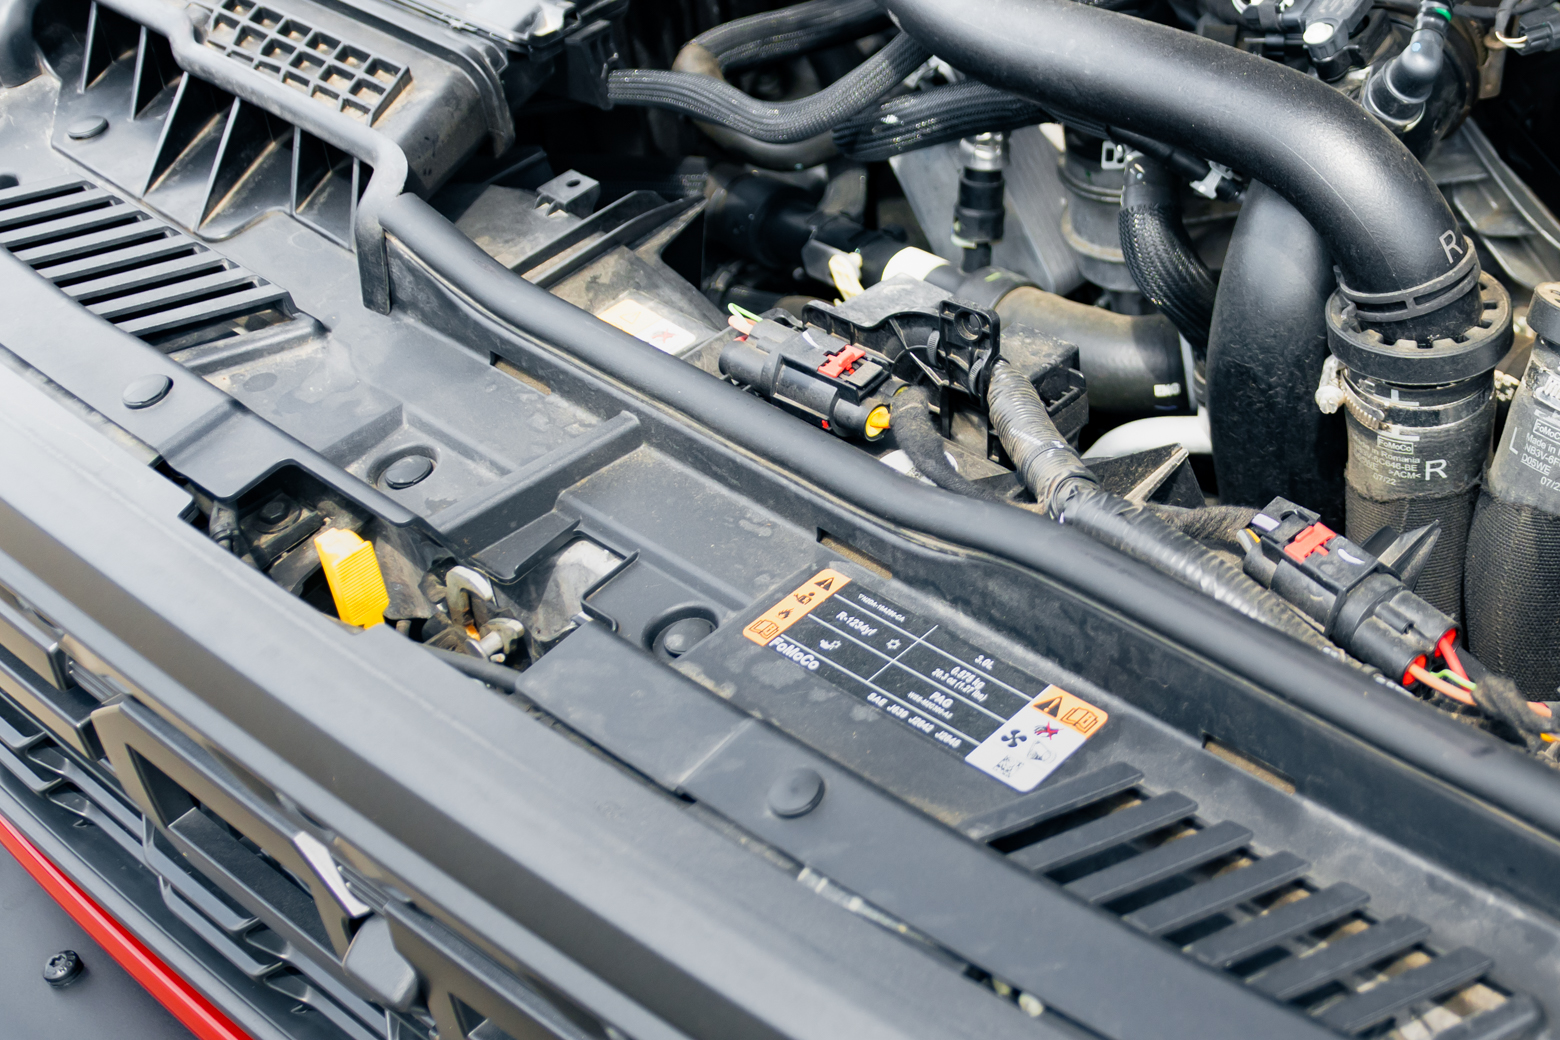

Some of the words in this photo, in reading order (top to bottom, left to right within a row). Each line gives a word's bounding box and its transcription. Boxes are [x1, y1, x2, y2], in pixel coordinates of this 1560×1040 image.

[1439, 229, 1463, 263] R
[1379, 439, 1412, 452] FoMoCo
[1509, 426, 1518, 455] L
[1526, 432, 1547, 449] Made
[1547, 444, 1556, 454] in
[1381, 451, 1421, 464] Romania
[1425, 459, 1448, 481] R
[836, 611, 878, 637] R-1234yf
[769, 636, 820, 671] FoMoCo
[974, 654, 995, 671] 3.0L
